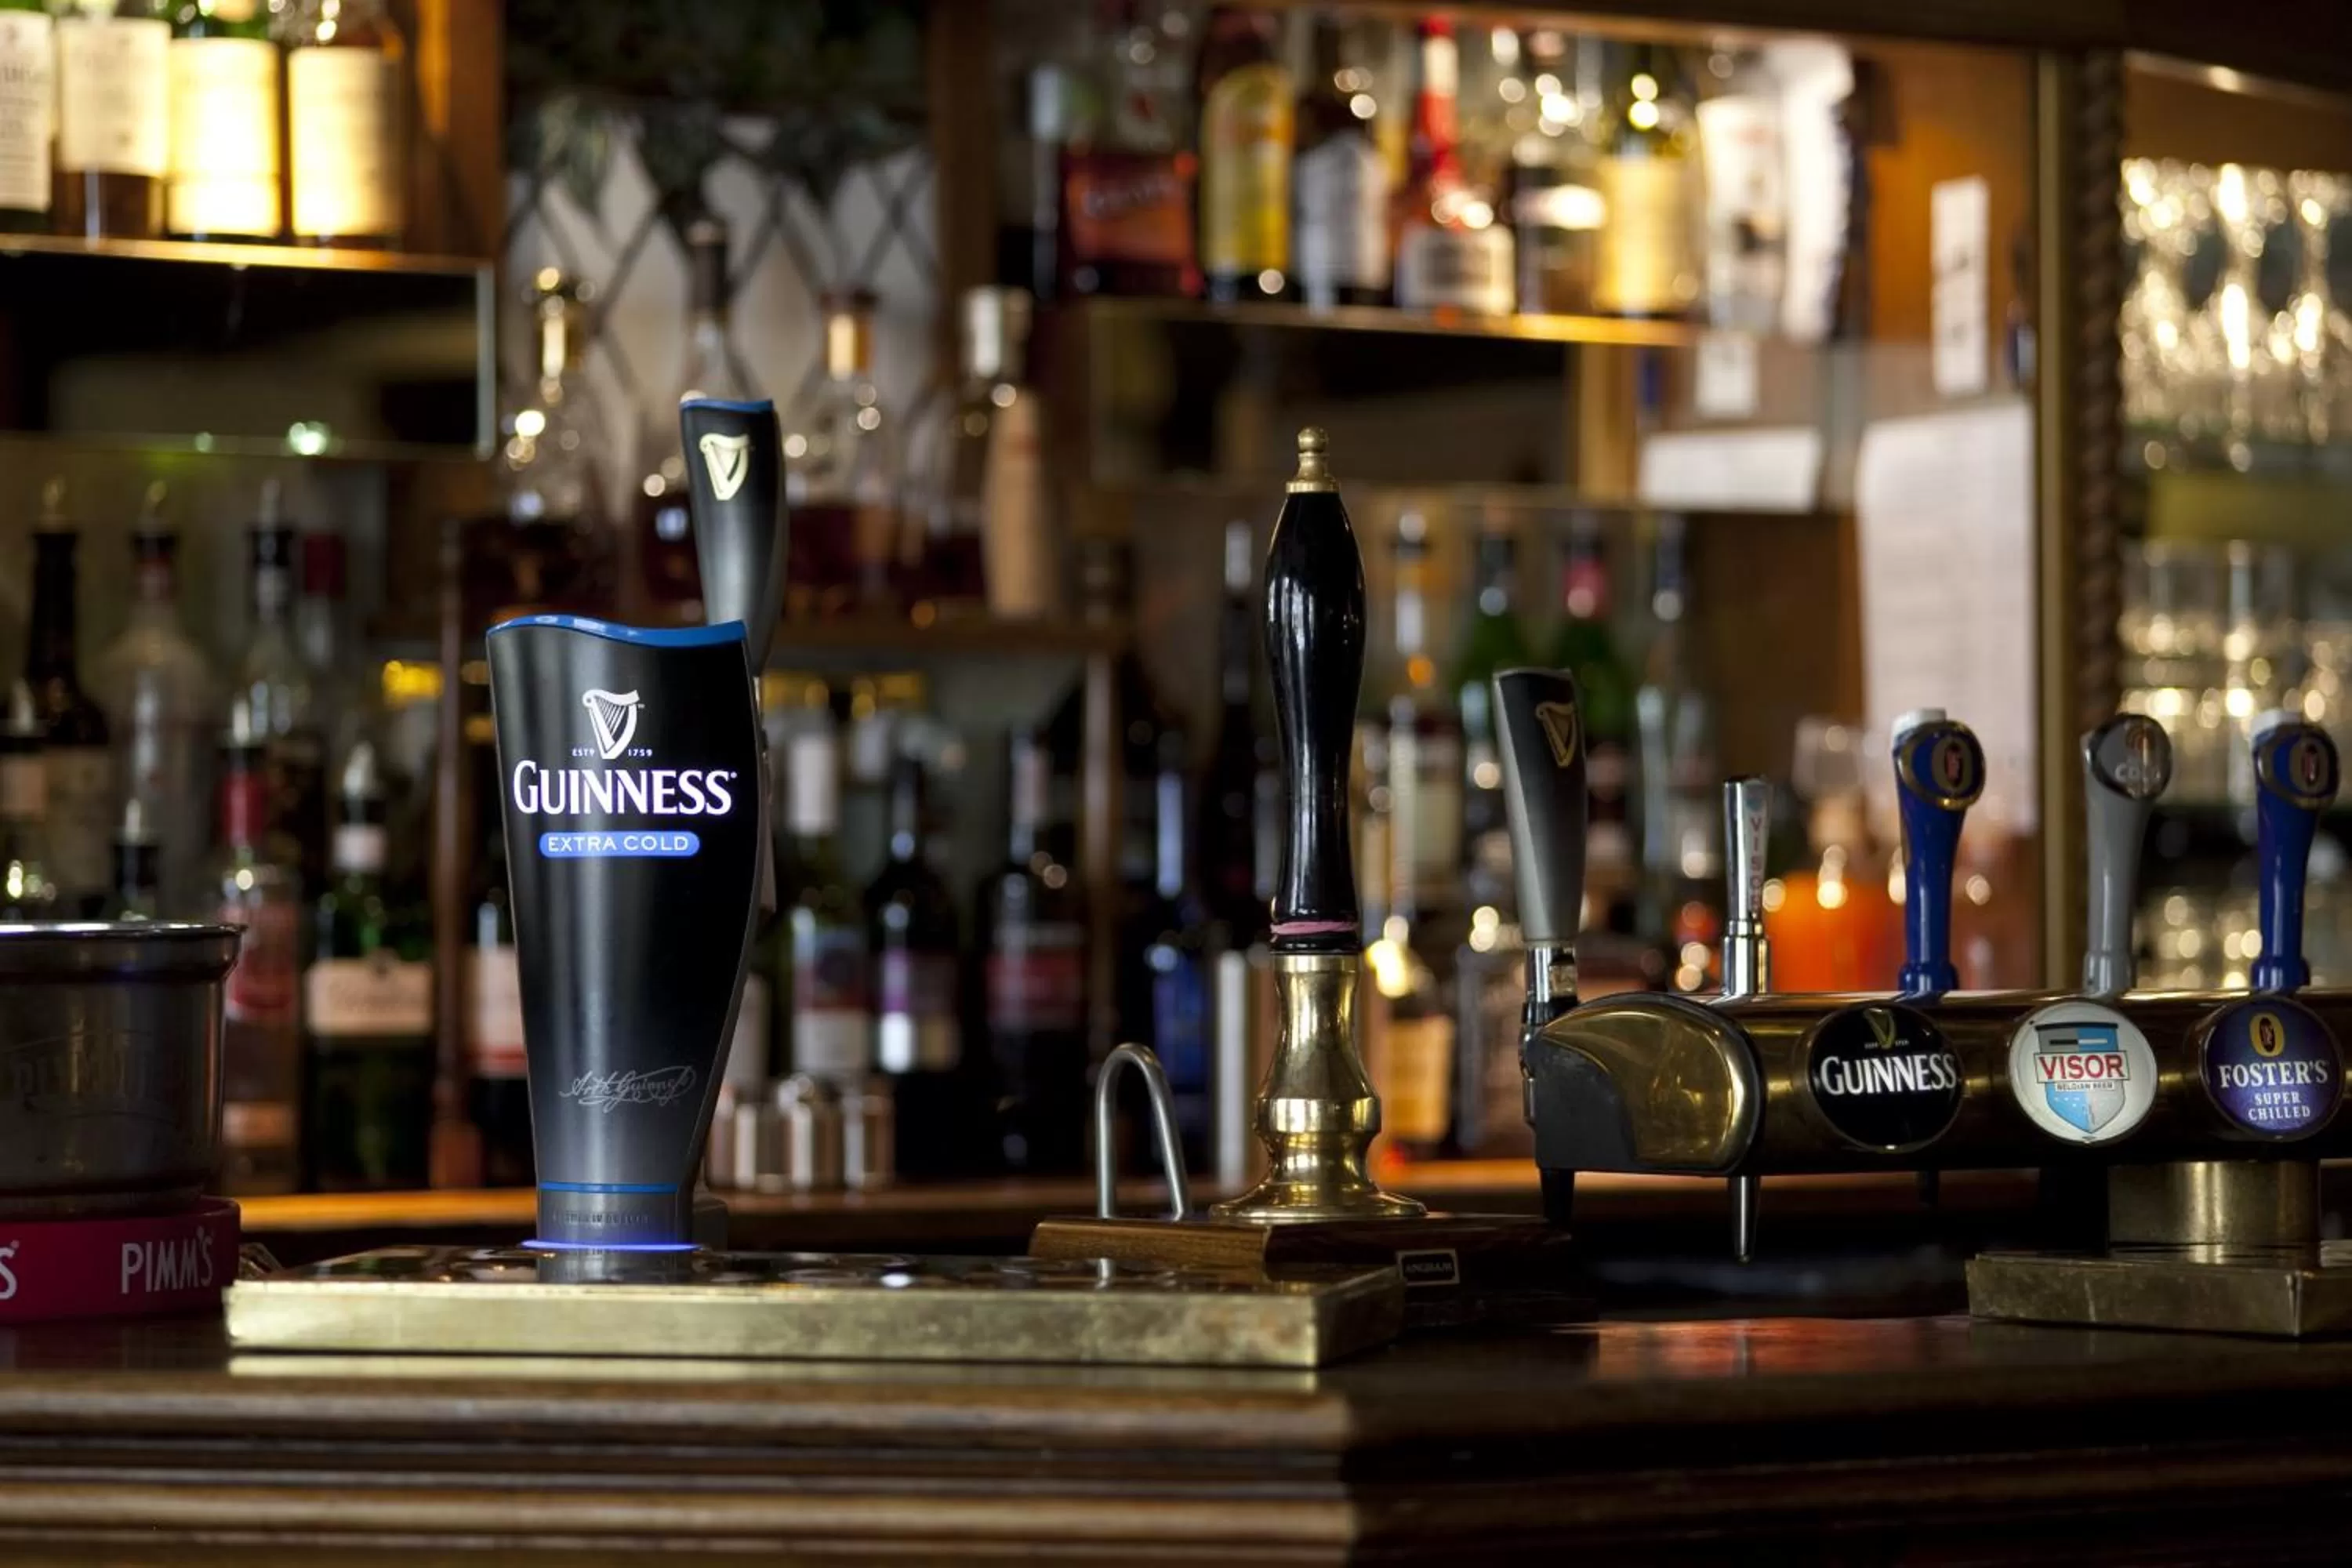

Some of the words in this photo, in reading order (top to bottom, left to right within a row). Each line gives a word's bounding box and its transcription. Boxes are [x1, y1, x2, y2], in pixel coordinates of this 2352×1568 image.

[627, 748, 652, 757] 1759
[514, 760, 734, 815] GUINNESS
[548, 836, 617, 852] EXTRA
[623, 835, 689, 851] COLD
[1820, 1053, 1958, 1096] GUINNESS
[2038, 1054, 2126, 1080] VISOR
[2218, 1059, 2329, 1089] FOSTER'S
[2254, 1091, 2301, 1105] SUPER
[2248, 1105, 2310, 1121] CHILLED
[121, 1225, 215, 1294] PIMM'S
